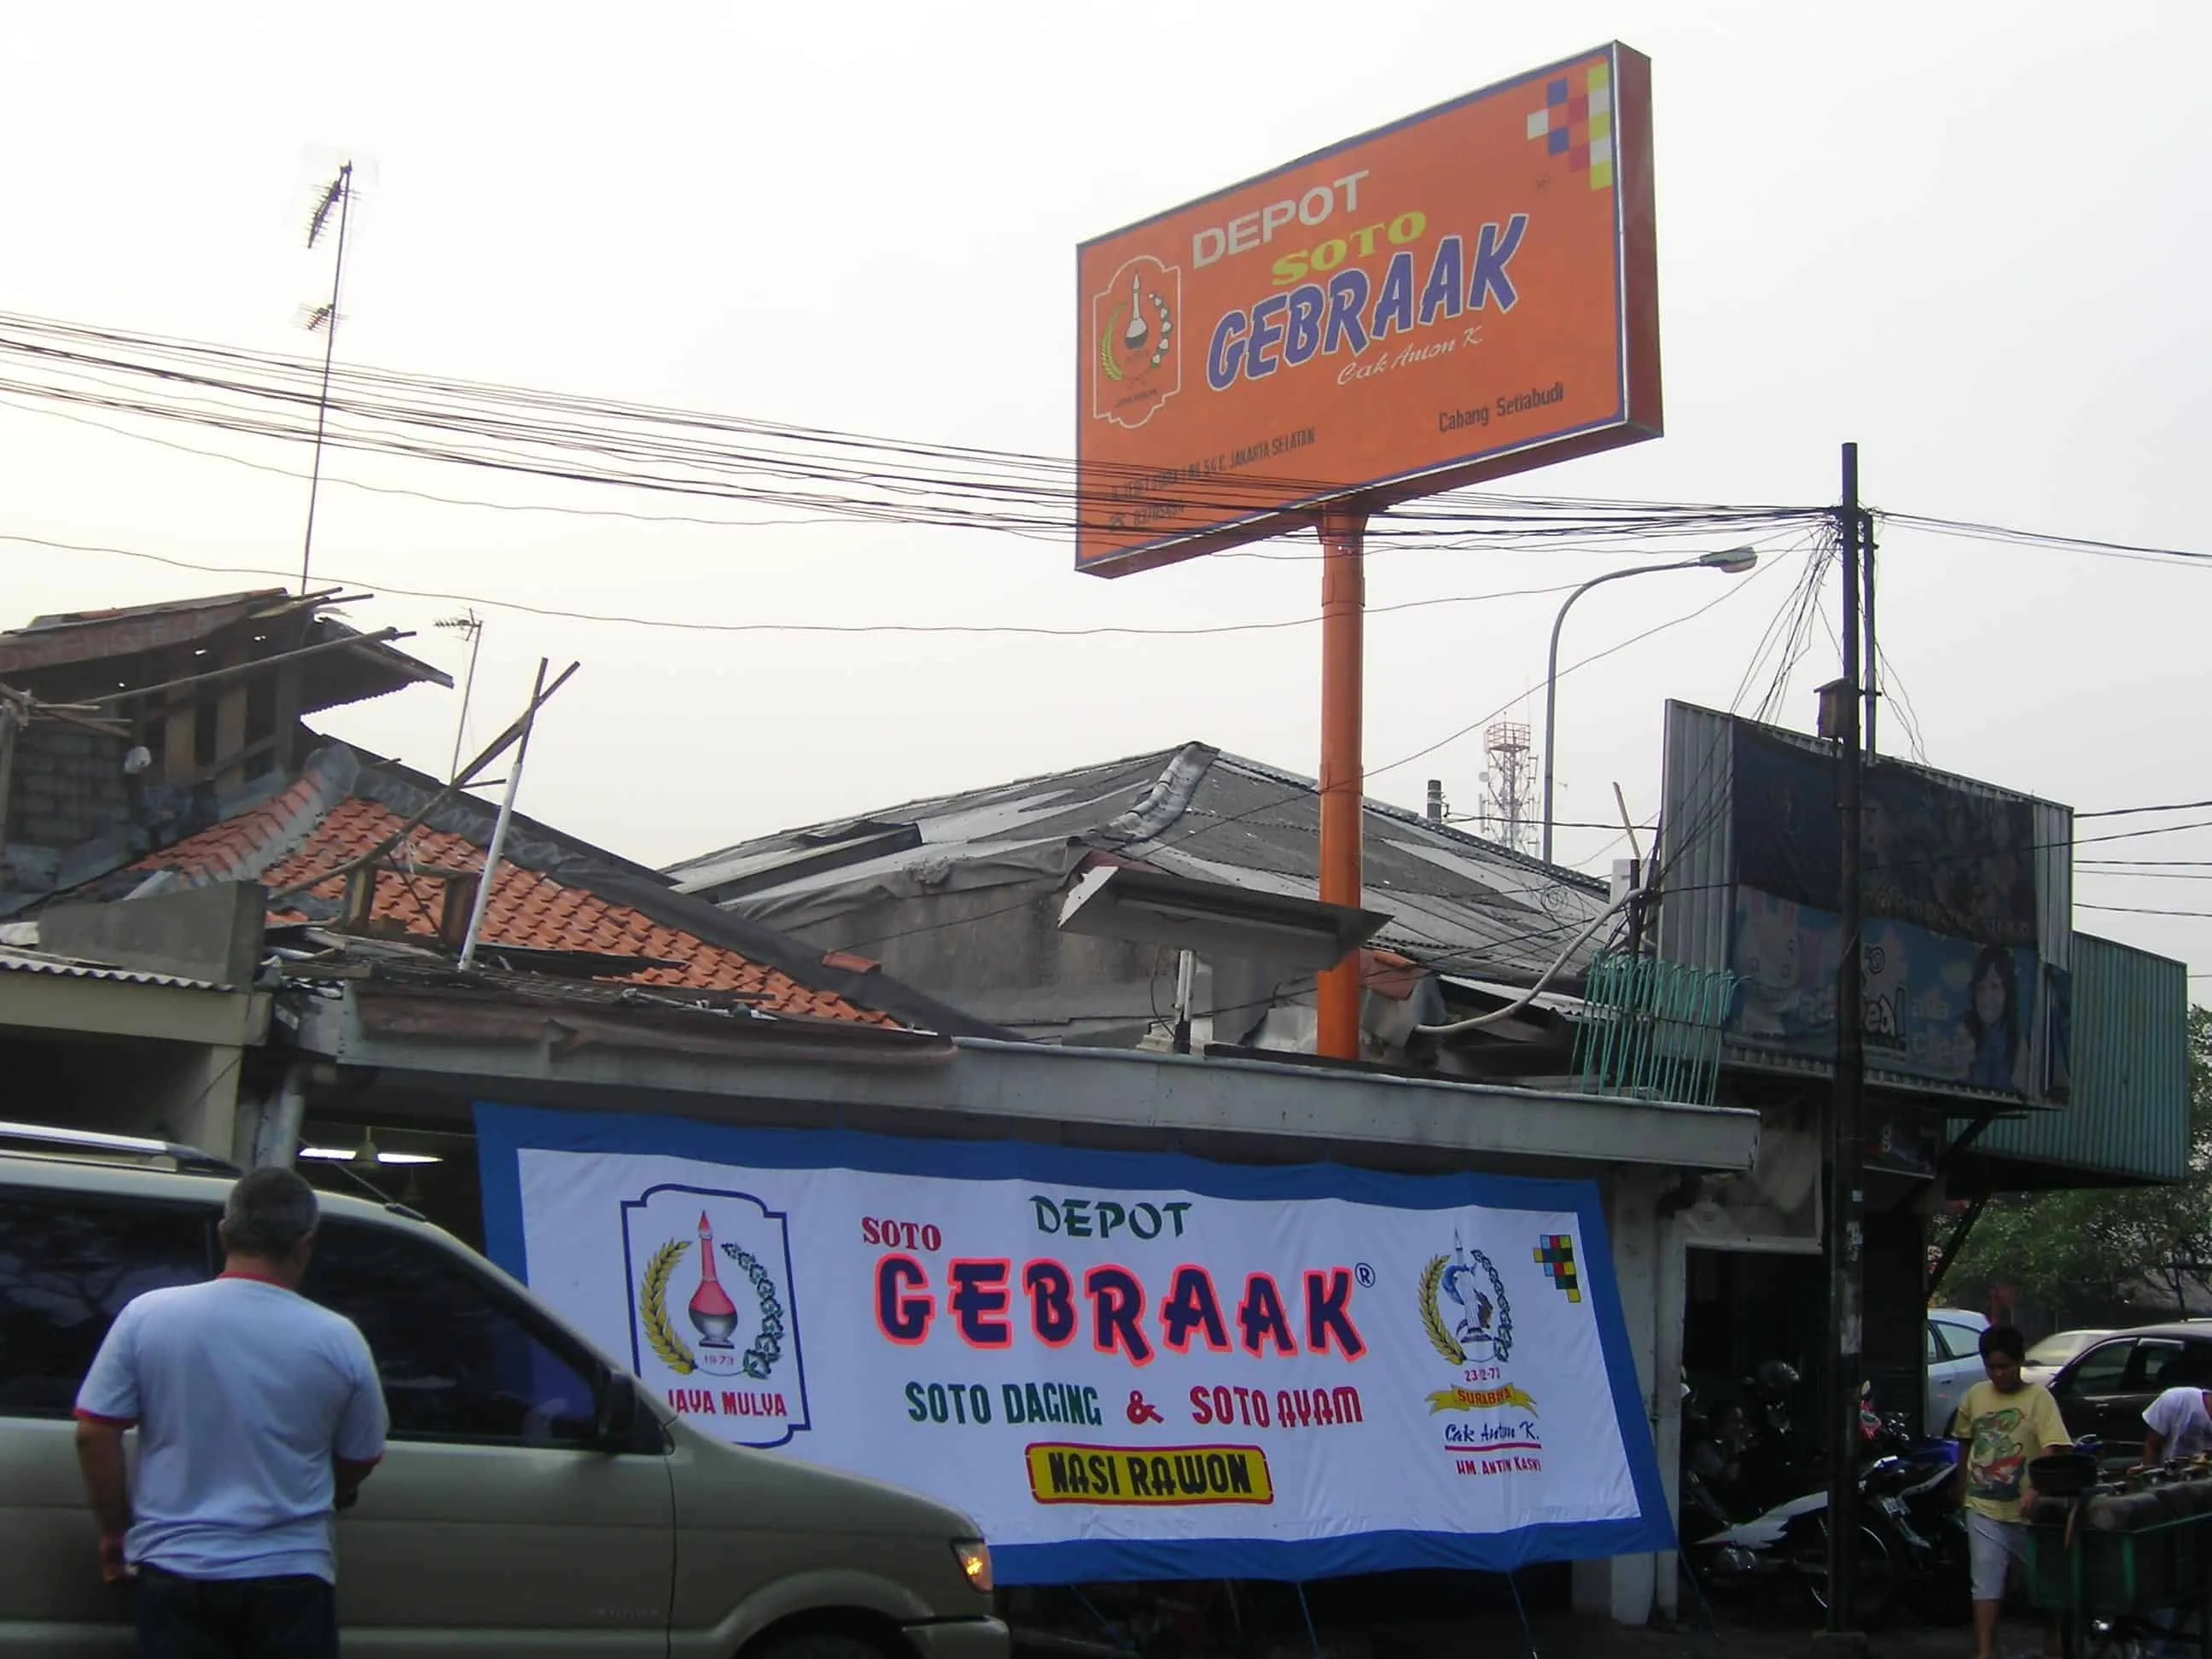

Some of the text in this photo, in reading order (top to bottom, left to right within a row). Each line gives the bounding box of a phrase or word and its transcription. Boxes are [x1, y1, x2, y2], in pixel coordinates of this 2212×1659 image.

[1193, 170, 1370, 270] DEPOT
[1272, 212, 1427, 286] SOTO
[1206, 213, 1529, 392] GEBRAAK
[1337, 352, 1388, 385] Cak
[1438, 381, 1564, 433] Cabang Setiabudi
[1231, 440, 1270, 469] JAKARTA
[1272, 426, 1316, 456] SELATAN
[861, 1216, 942, 1252] SOTO
[1028, 1195, 1193, 1239] DEPOT
[874, 1253, 1367, 1367] GEBRAAK
[722, 1391, 788, 1417] MULYA
[905, 1381, 1364, 1428] SOTO DAGING & SOTO AYAM
[1445, 1423, 1475, 1442] Cak
[1048, 1452, 1252, 1496] NASI RAWON
